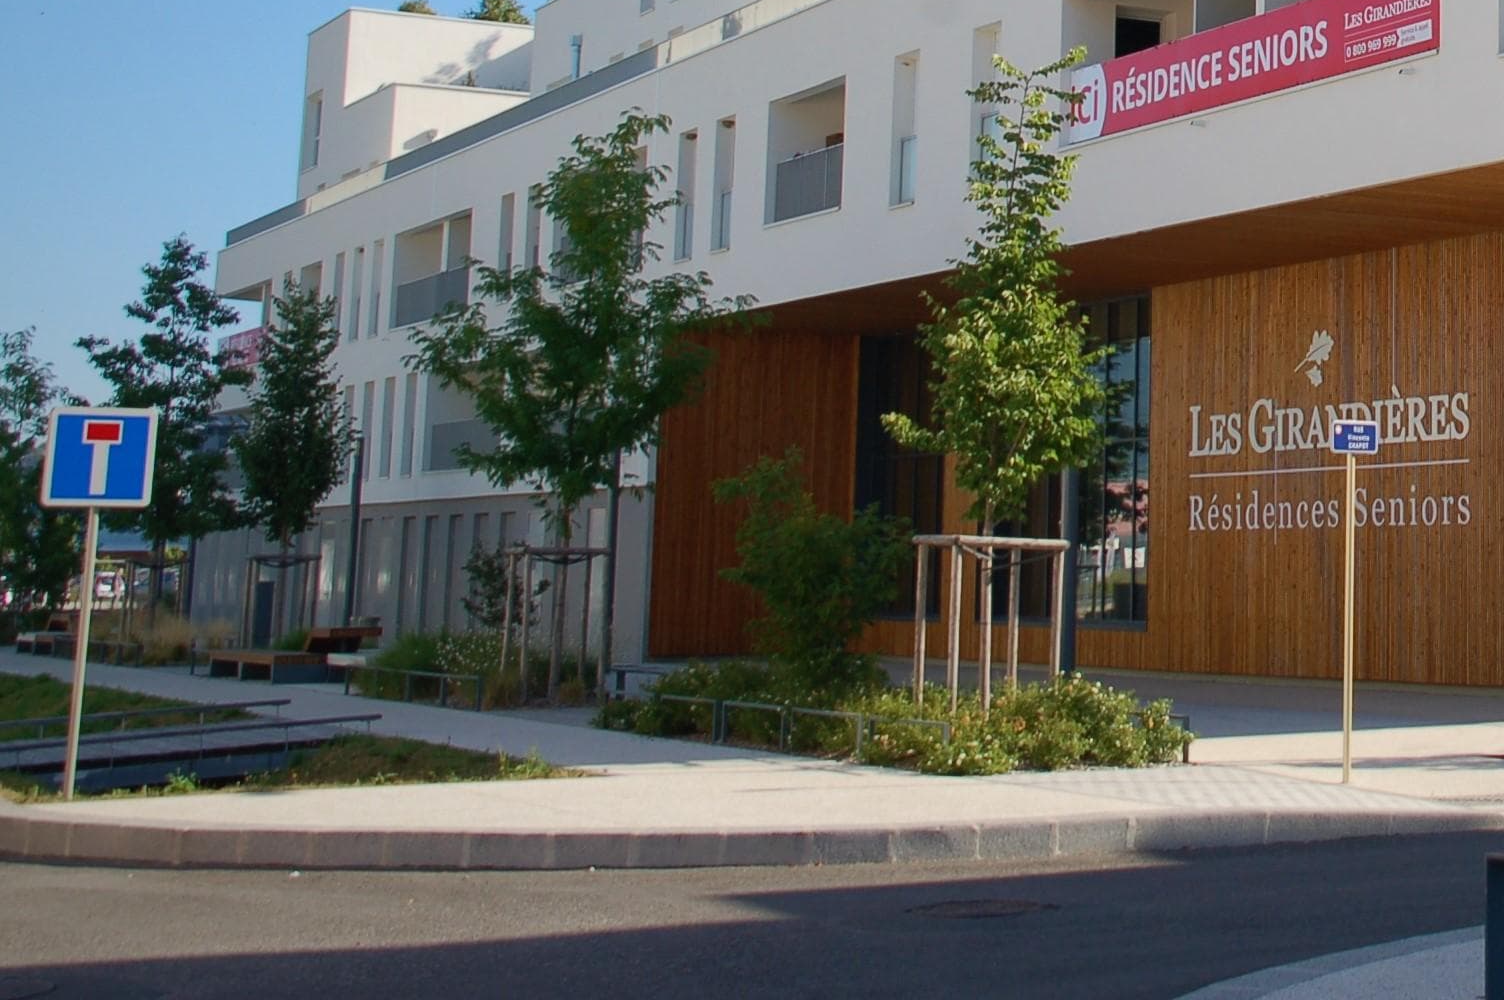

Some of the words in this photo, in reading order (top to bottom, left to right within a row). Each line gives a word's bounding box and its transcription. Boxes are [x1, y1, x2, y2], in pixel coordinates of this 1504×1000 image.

[1344, 12, 1362, 30] LES
[1112, 51, 1222, 114] RÉSIDENCE
[1228, 21, 1328, 81] SENIORS
[1188, 405, 1242, 457] LES
[1188, 490, 1339, 531] Résidences
[1354, 484, 1471, 527] Seniors
